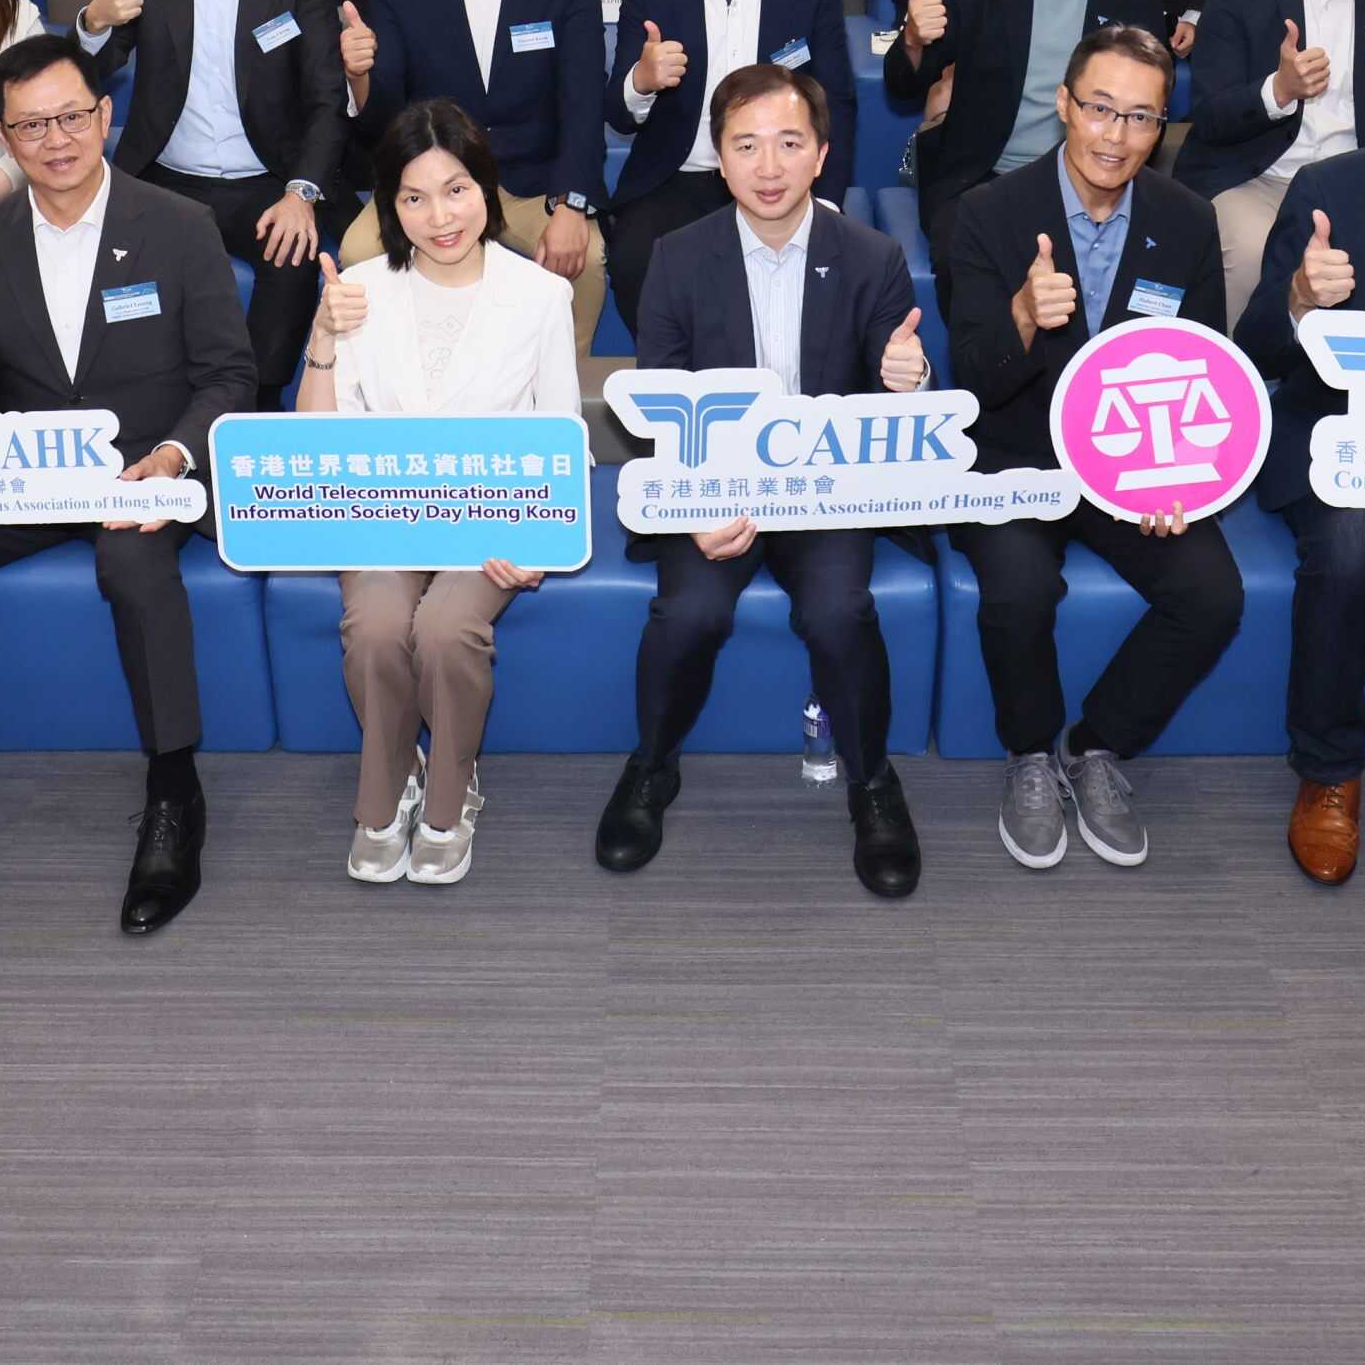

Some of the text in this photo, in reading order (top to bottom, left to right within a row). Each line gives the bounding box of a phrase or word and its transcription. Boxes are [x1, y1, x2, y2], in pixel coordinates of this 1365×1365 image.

[756, 413, 958, 467] CAHK
[231, 454, 572, 477] 香港世界電訊及資訊社會日
[254, 484, 550, 500] World Telecommunication and
[642, 475, 836, 499] 香港通訊業聯會
[12, 498, 91, 512] Association
[94, 496, 109, 510] of
[111, 495, 150, 511] Hong
[154, 493, 192, 509] Kong
[230, 504, 577, 523] Information Society Day Hong Kong
[641, 490, 1062, 520] Communications Association of Hong Kong
